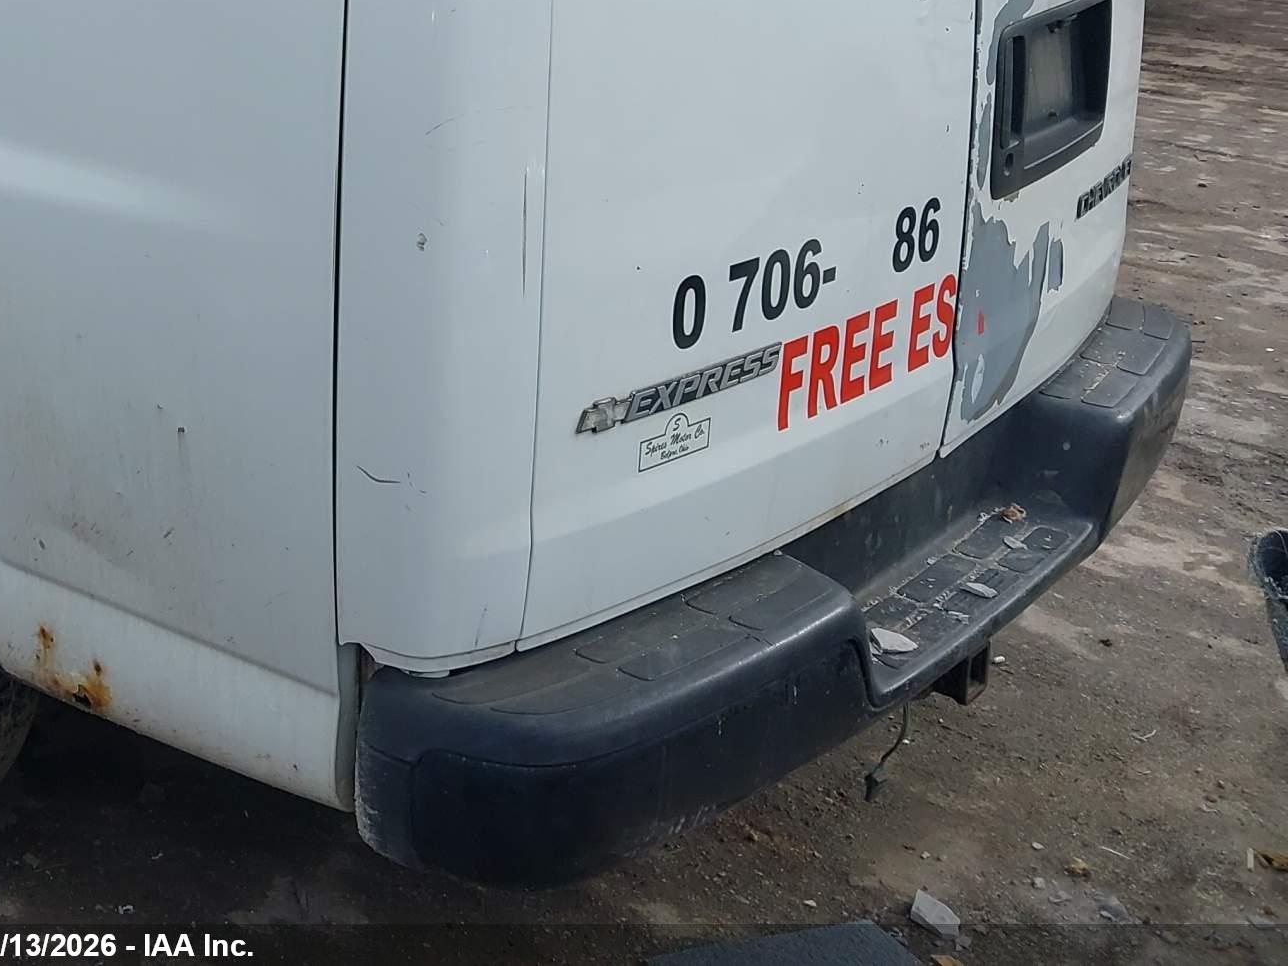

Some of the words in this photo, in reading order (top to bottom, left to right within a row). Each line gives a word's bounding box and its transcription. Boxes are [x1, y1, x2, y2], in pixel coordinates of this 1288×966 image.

[672, 274, 706, 350] 0
[728, 239, 837, 333] 706-
[892, 197, 941, 273] 86
[621, 342, 783, 425] EXPRESS
[777, 298, 899, 432] FREE
[907, 273, 957, 373] ES
